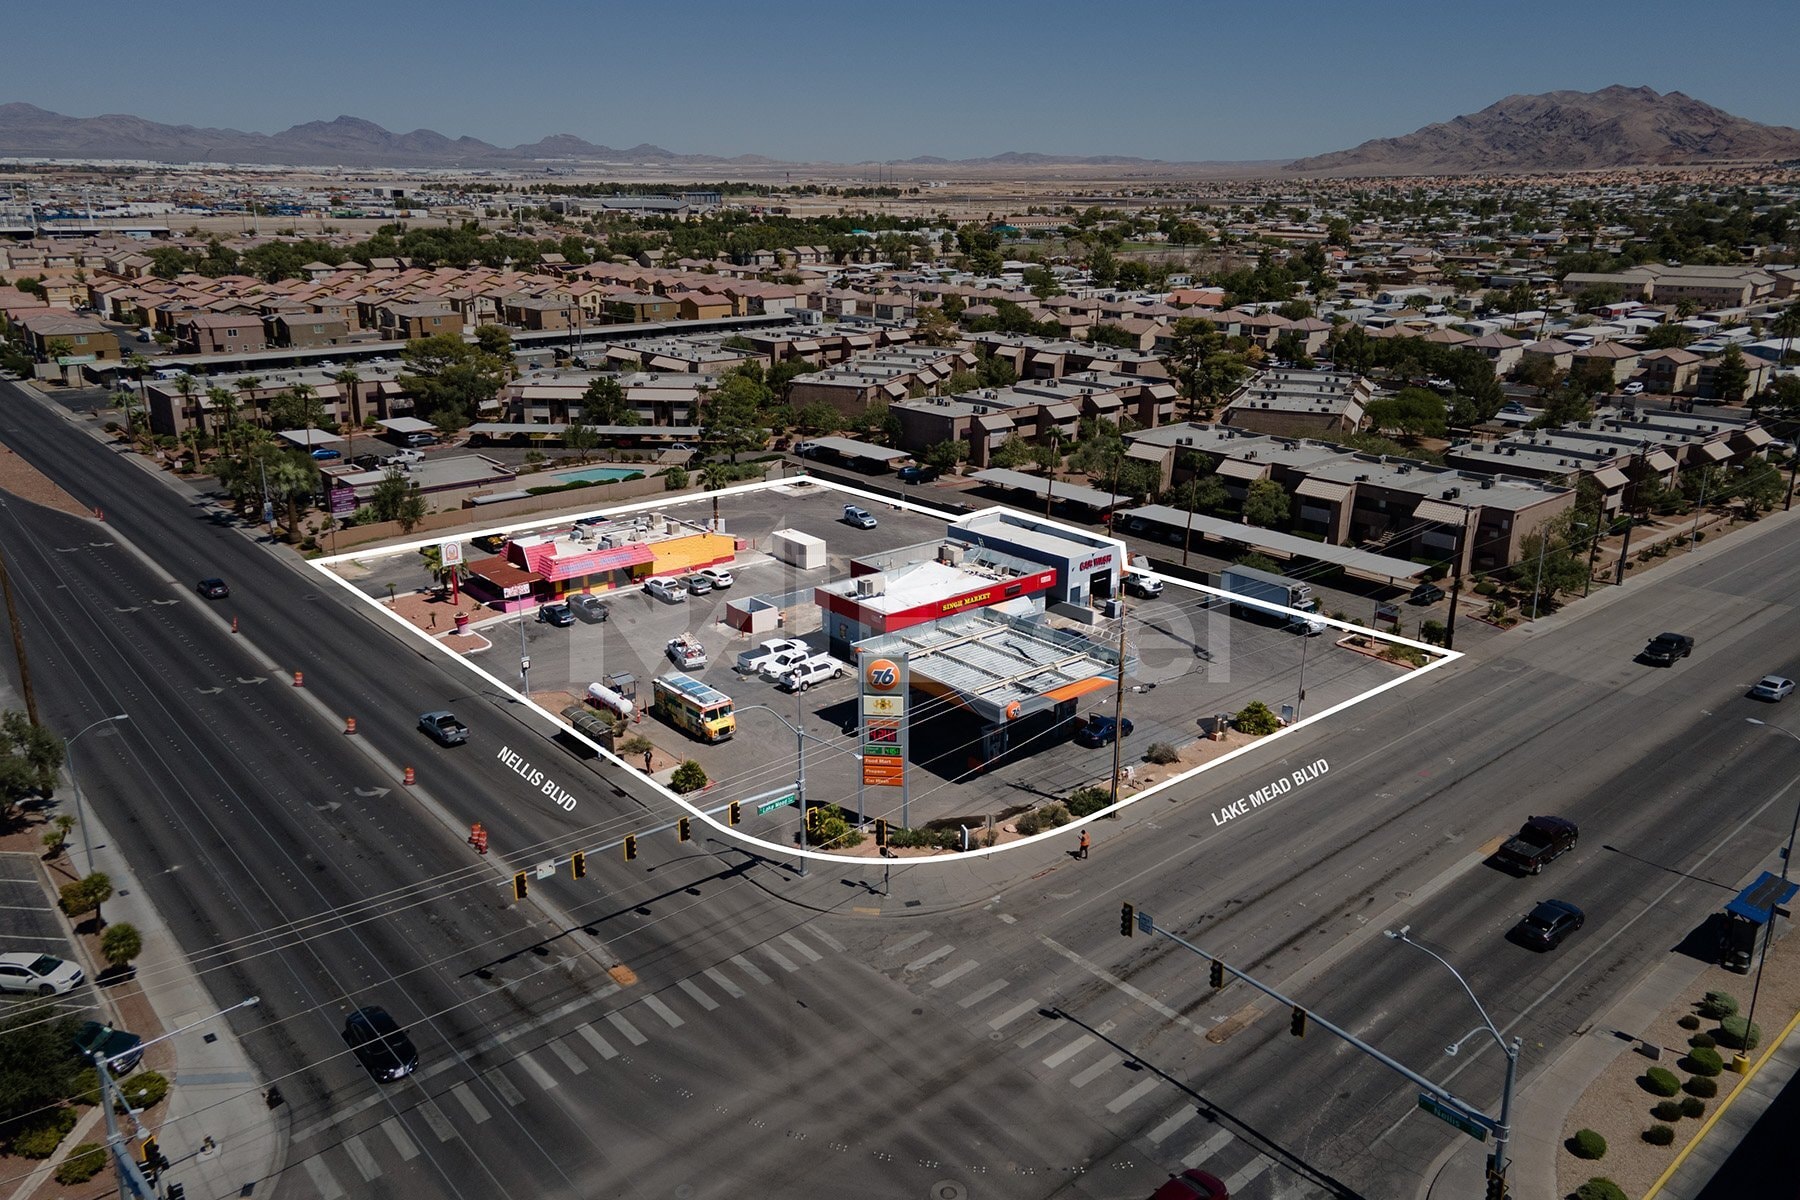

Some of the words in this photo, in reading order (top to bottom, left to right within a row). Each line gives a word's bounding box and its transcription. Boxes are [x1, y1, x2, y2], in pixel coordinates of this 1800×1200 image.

[942, 600, 963, 612] SINGH
[963, 592, 991, 605] MARKET
[871, 667, 896, 685] 76
